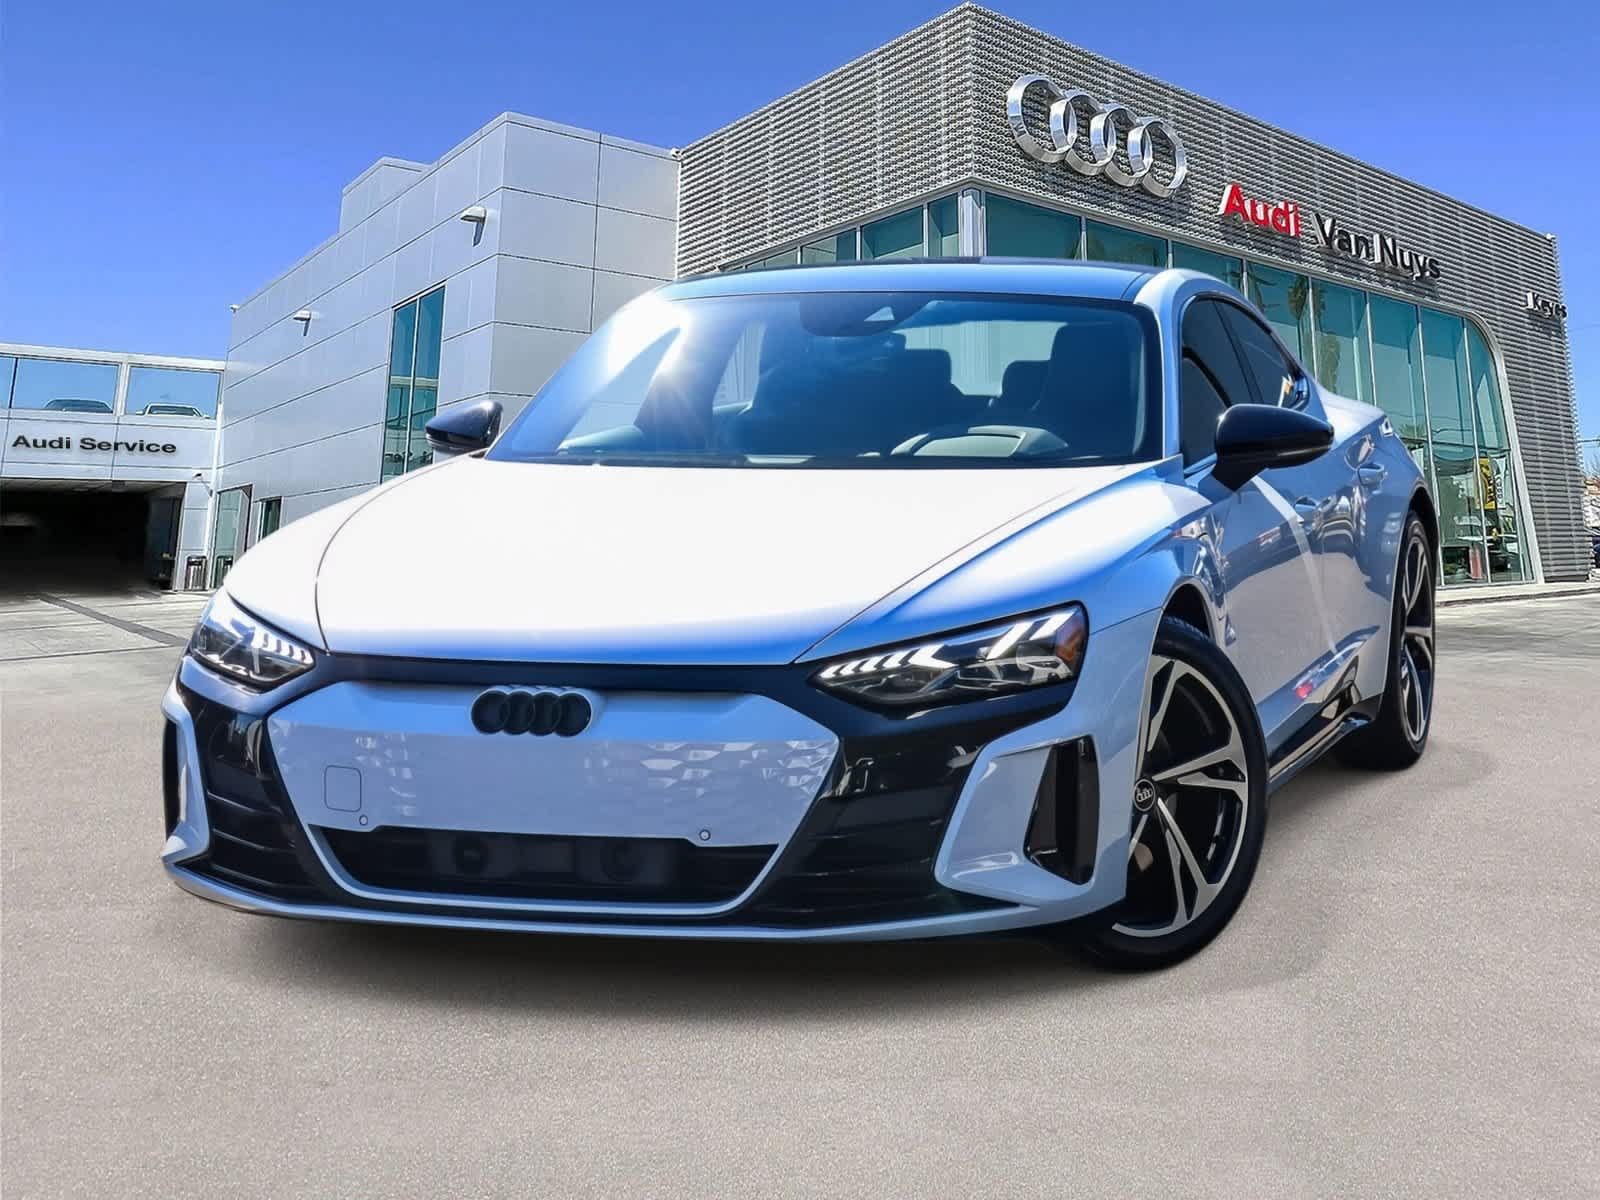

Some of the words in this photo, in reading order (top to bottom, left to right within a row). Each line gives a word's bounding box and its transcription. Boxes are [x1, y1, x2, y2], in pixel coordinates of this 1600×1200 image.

[1218, 182, 1302, 237] Audi
[1312, 213, 1372, 258] Van
[1374, 233, 1441, 280] Nuys
[12, 435, 71, 449] Audi
[79, 437, 177, 453] Service
